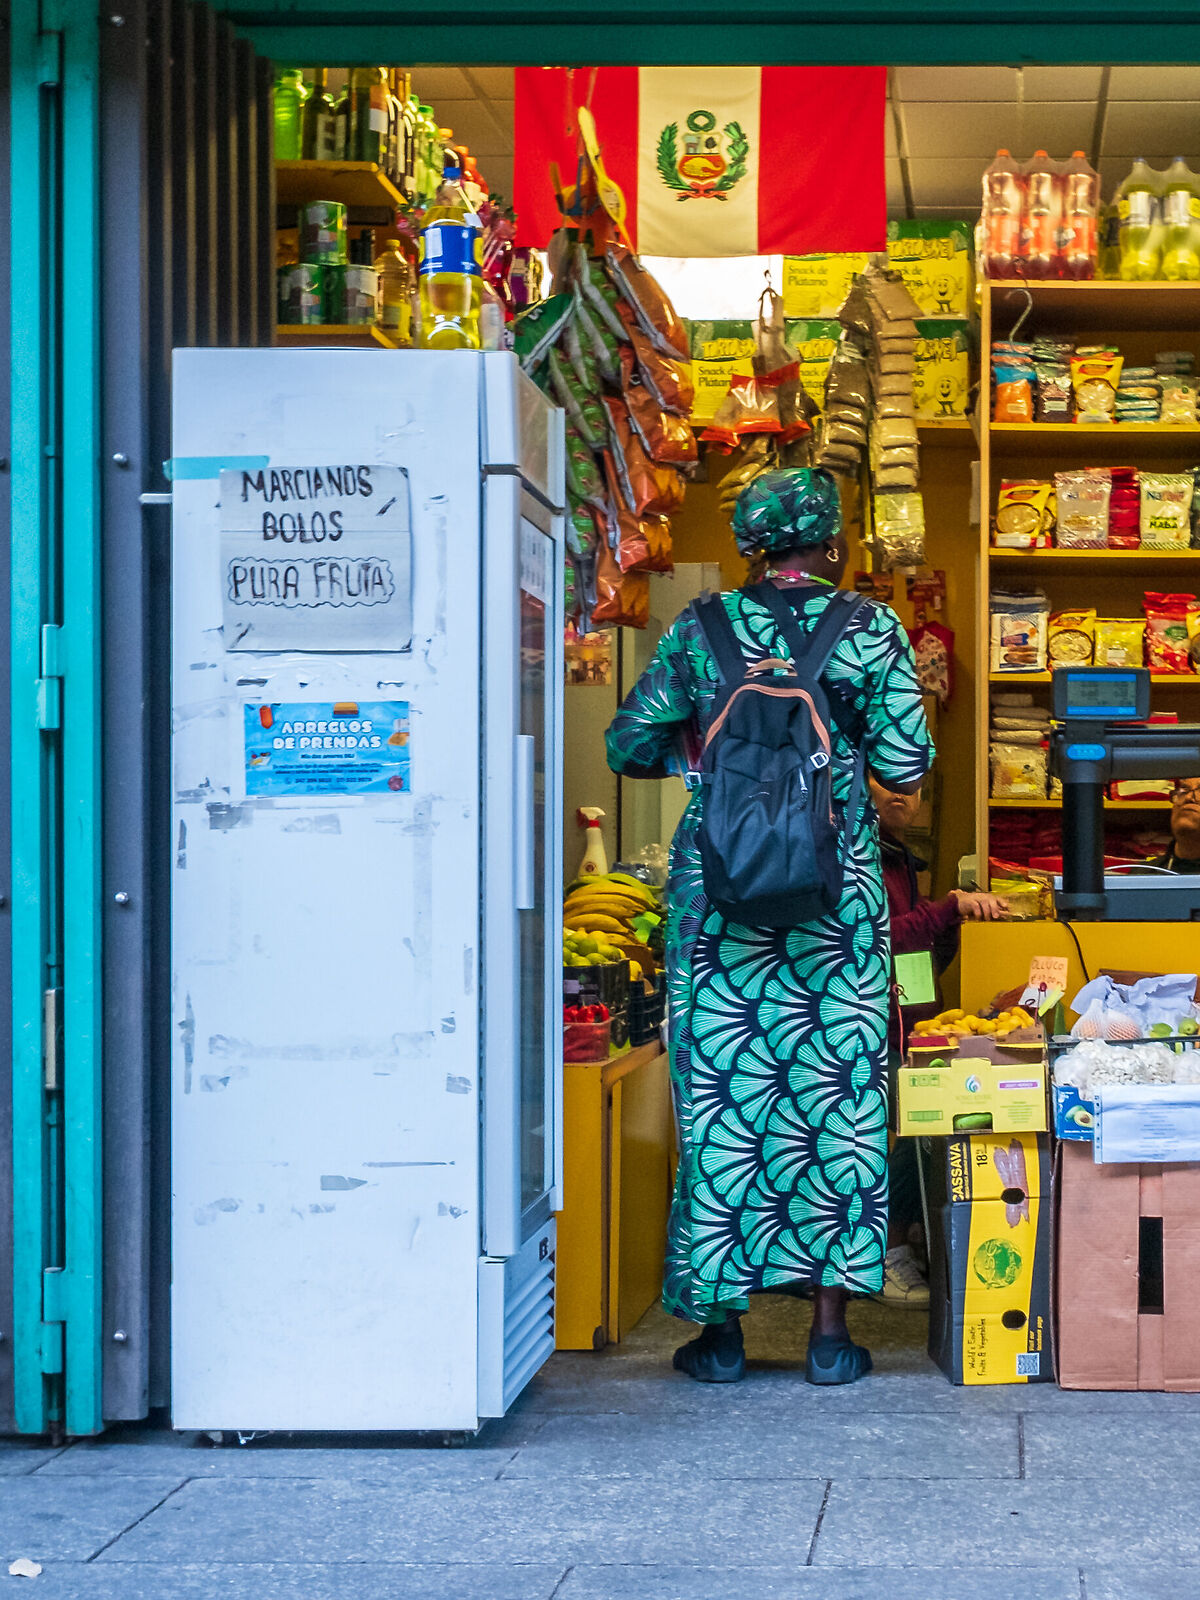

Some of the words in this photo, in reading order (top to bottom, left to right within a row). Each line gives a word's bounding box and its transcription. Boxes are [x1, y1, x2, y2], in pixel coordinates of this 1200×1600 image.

[698, 366, 726, 376] Snack
[240, 465, 374, 503] MARCIANOS
[262, 510, 344, 543] BOLOS
[232, 564, 300, 600] PURA
[313, 562, 384, 598] FRUTA
[281, 720, 373, 734] ARREGLOS
[273, 737, 296, 750] DE
[300, 735, 382, 749] PRENDAS
[976, 1154, 988, 1168] 18
[977, 1318, 988, 1349] Vegetables
